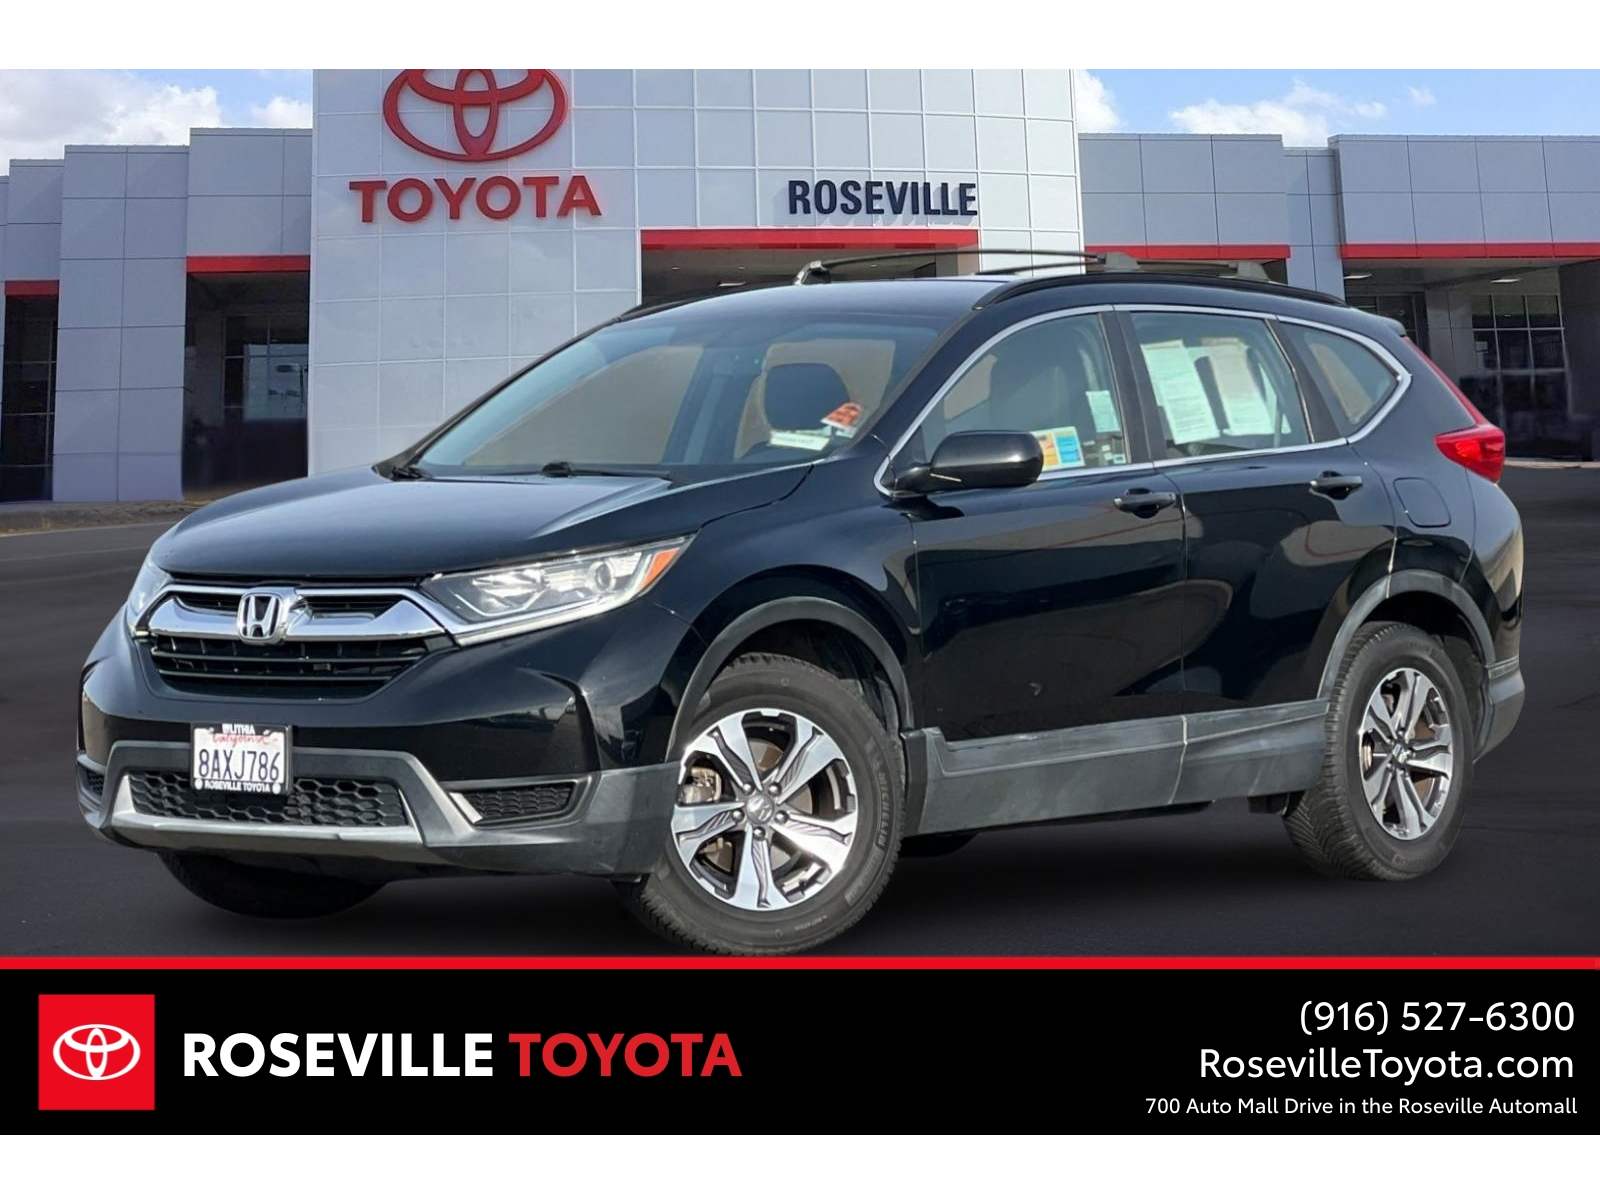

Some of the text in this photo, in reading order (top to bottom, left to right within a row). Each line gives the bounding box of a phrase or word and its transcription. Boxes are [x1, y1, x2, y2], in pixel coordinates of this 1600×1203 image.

[349, 174, 603, 224] TOYOTA
[787, 179, 979, 217] ROSEVILLE
[198, 748, 281, 781] 8AXJ786
[204, 780, 271, 793] ROSEVILLE TOYOTA
